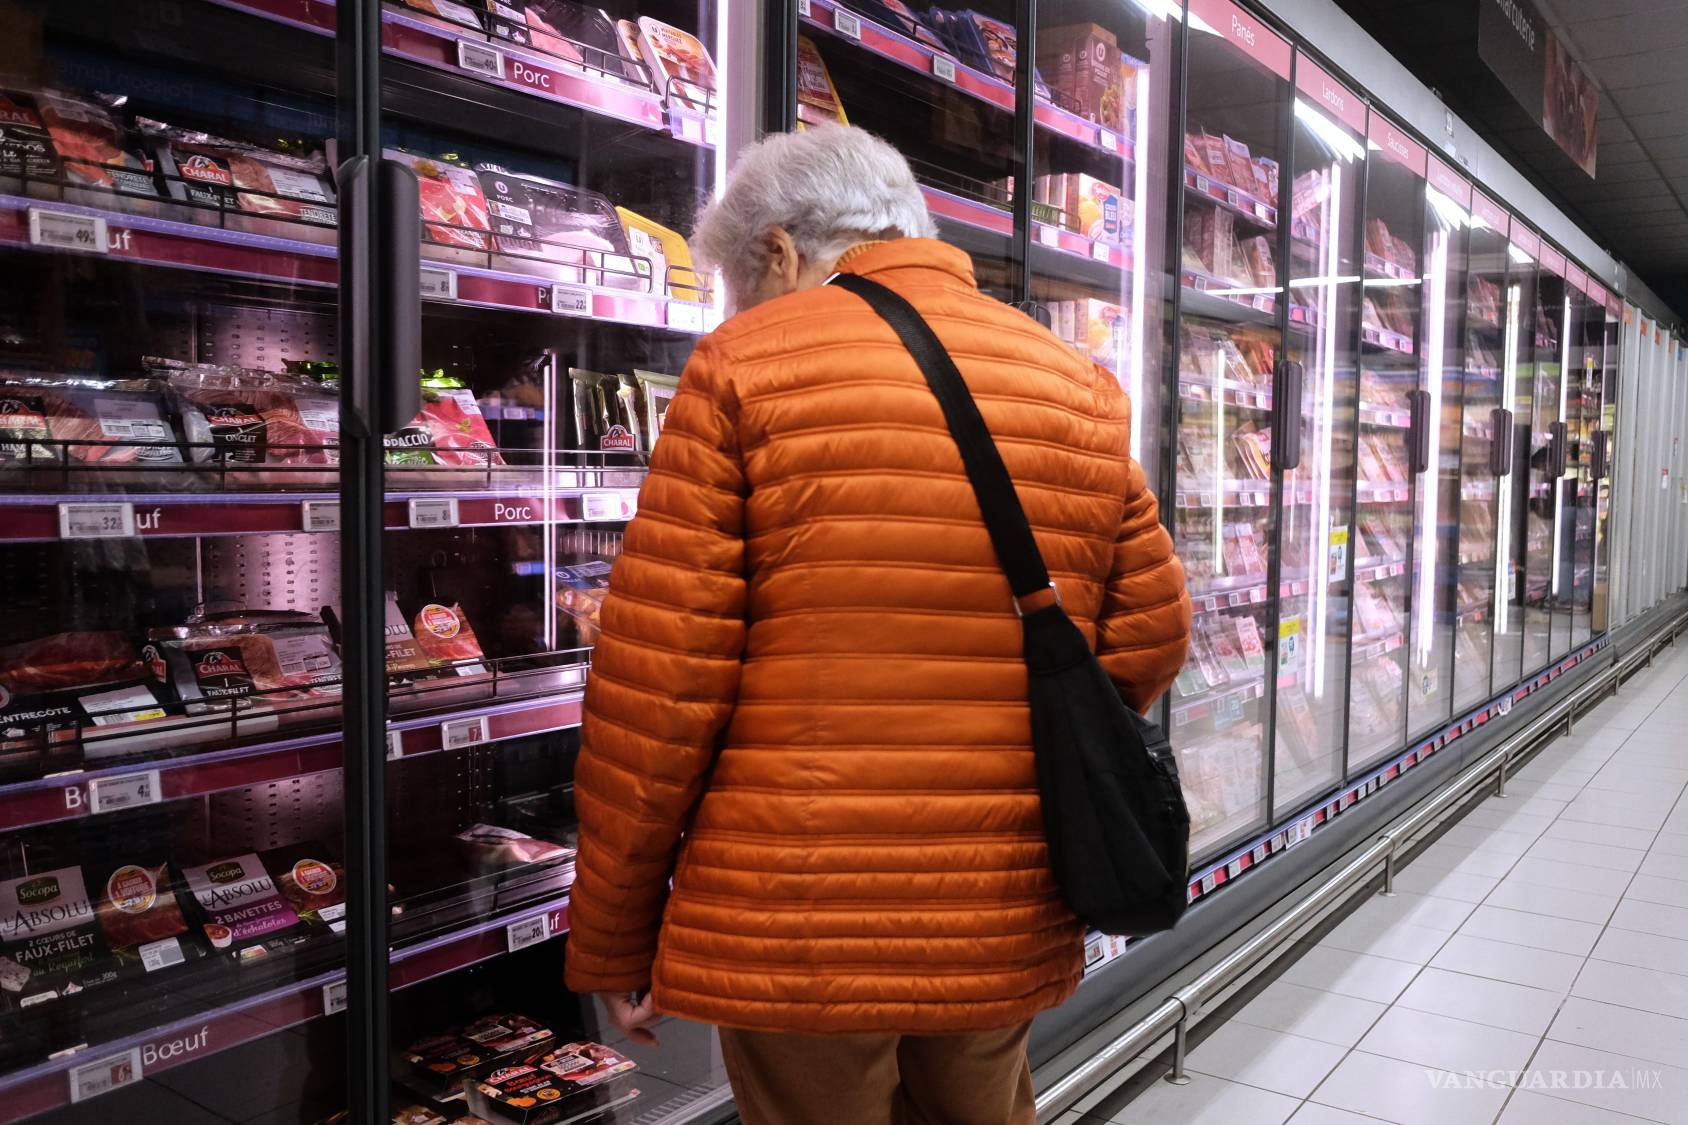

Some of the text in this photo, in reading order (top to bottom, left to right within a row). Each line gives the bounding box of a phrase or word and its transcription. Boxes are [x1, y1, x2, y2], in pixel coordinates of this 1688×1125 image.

[1231, 14, 1255, 47] Panés
[1496, 0, 1535, 51] arcuterie
[513, 62, 550, 88] Porc
[1322, 79, 1345, 112] Lardons
[182, 166, 226, 182] CHARAL
[603, 437, 631, 448] CHARAL
[494, 503, 532, 520] Porc
[199, 664, 241, 674] CHARAL
[209, 867, 242, 881] Socopa
[20, 884, 58, 900] Socopa
[202, 878, 272, 909] L'ABSOLU
[4, 900, 88, 935] L'ABSOLU
[215, 900, 283, 925] 2 BAVETTES
[15, 933, 95, 963] FAUX-FILET
[143, 1025, 209, 1066] Bœuf
[490, 1066, 532, 1083] CHARAL
